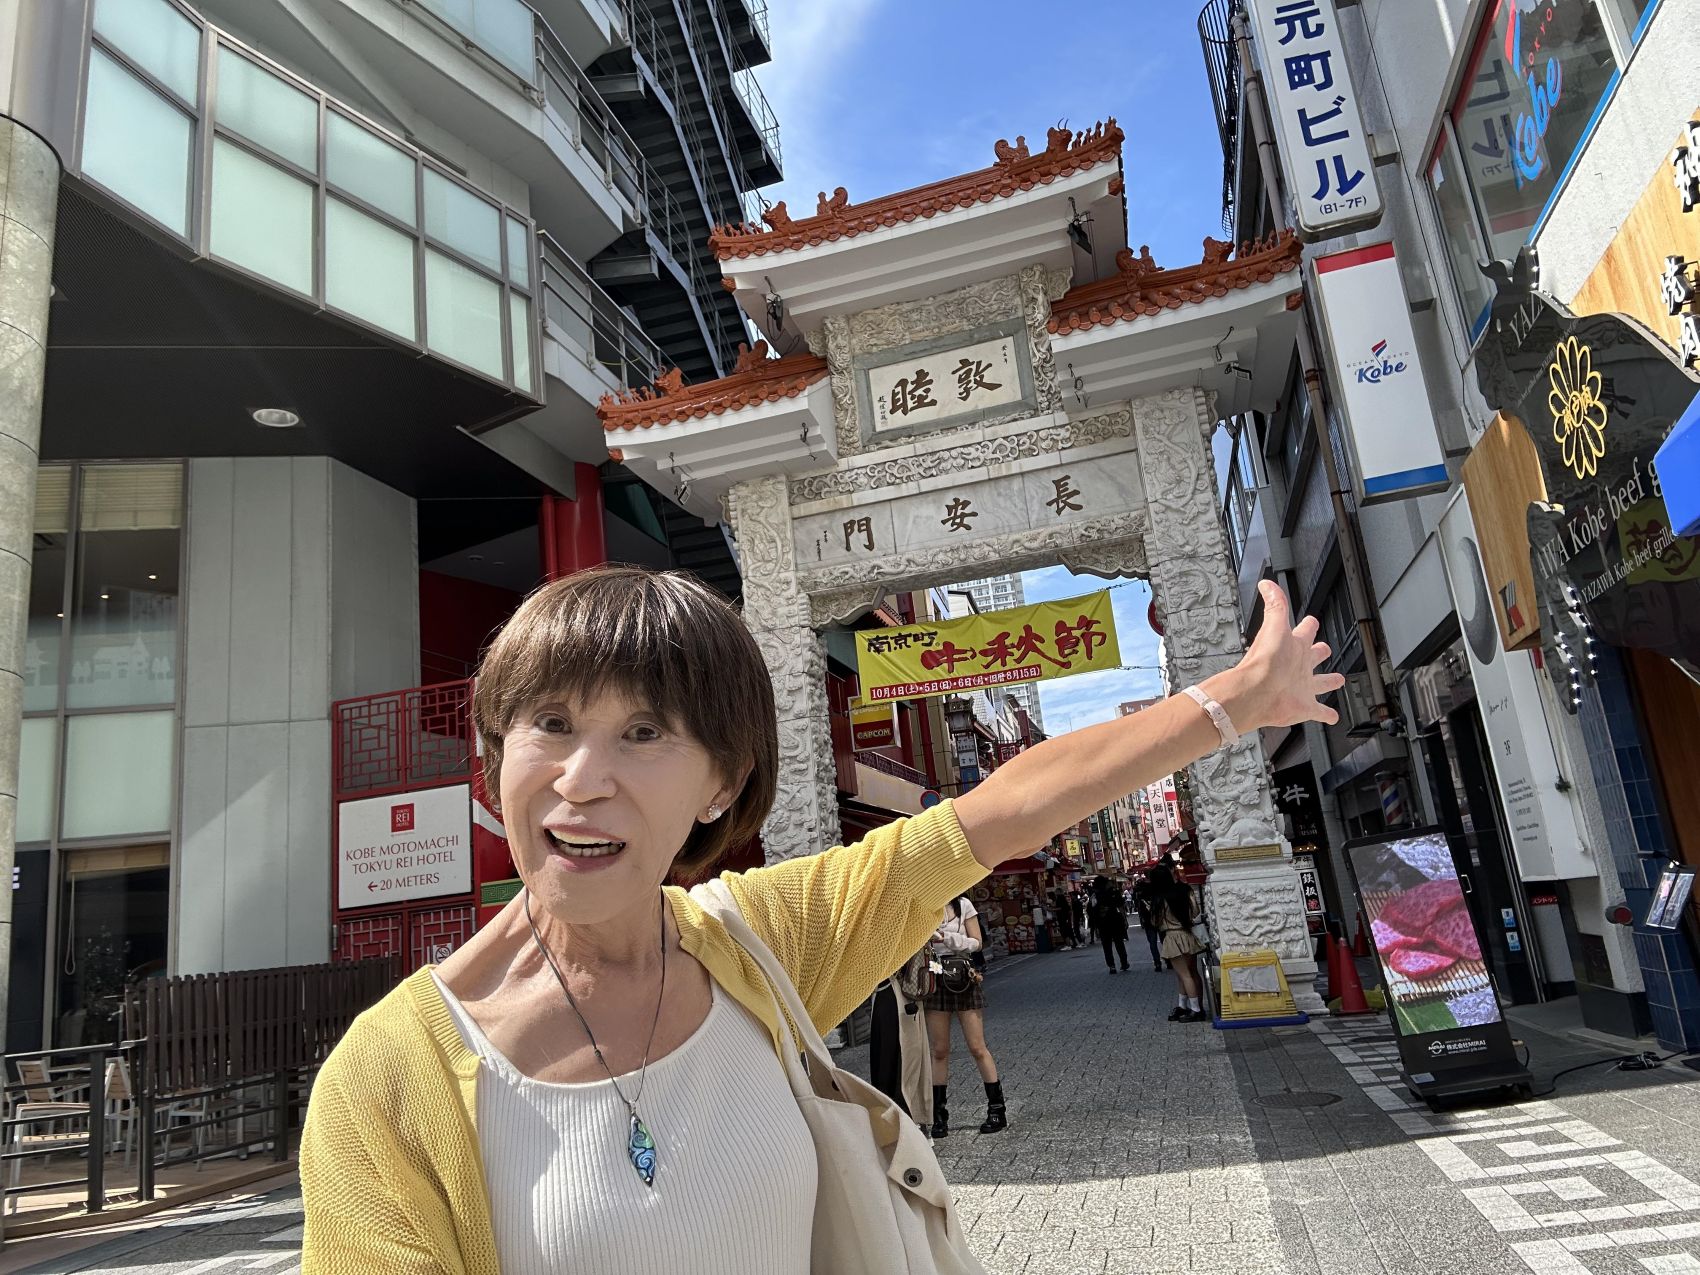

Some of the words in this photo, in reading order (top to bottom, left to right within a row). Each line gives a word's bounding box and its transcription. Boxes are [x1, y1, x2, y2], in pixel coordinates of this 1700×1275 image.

[1274, 0, 1365, 201] 元町ビル
[1509, 57, 1563, 192] Kobe
[1508, 295, 1546, 347] YAZ
[1346, 359, 1375, 368] OCEAN
[1381, 351, 1410, 360] TOKYO
[1355, 360, 1407, 384] Kobe
[1567, 504, 1608, 556] Kobe
[1605, 456, 1646, 520] beef
[1581, 570, 1616, 604] YAZAWA
[1613, 558, 1635, 582] Kobe
[1632, 538, 1652, 567] beef
[867, 631, 938, 655] 南京町
[920, 614, 1108, 674] 中秋節
[857, 728, 891, 740] CAPCOM
[395, 813, 410, 823] REI
[346, 846, 376, 862] KOBE
[379, 834, 459, 857] MOTOMACHI
[352, 859, 393, 875] TOKYU
[396, 856, 413, 869] REI
[416, 850, 456, 866] HOTEL
[380, 879, 392, 891] 20
[395, 872, 440, 889] METERS
